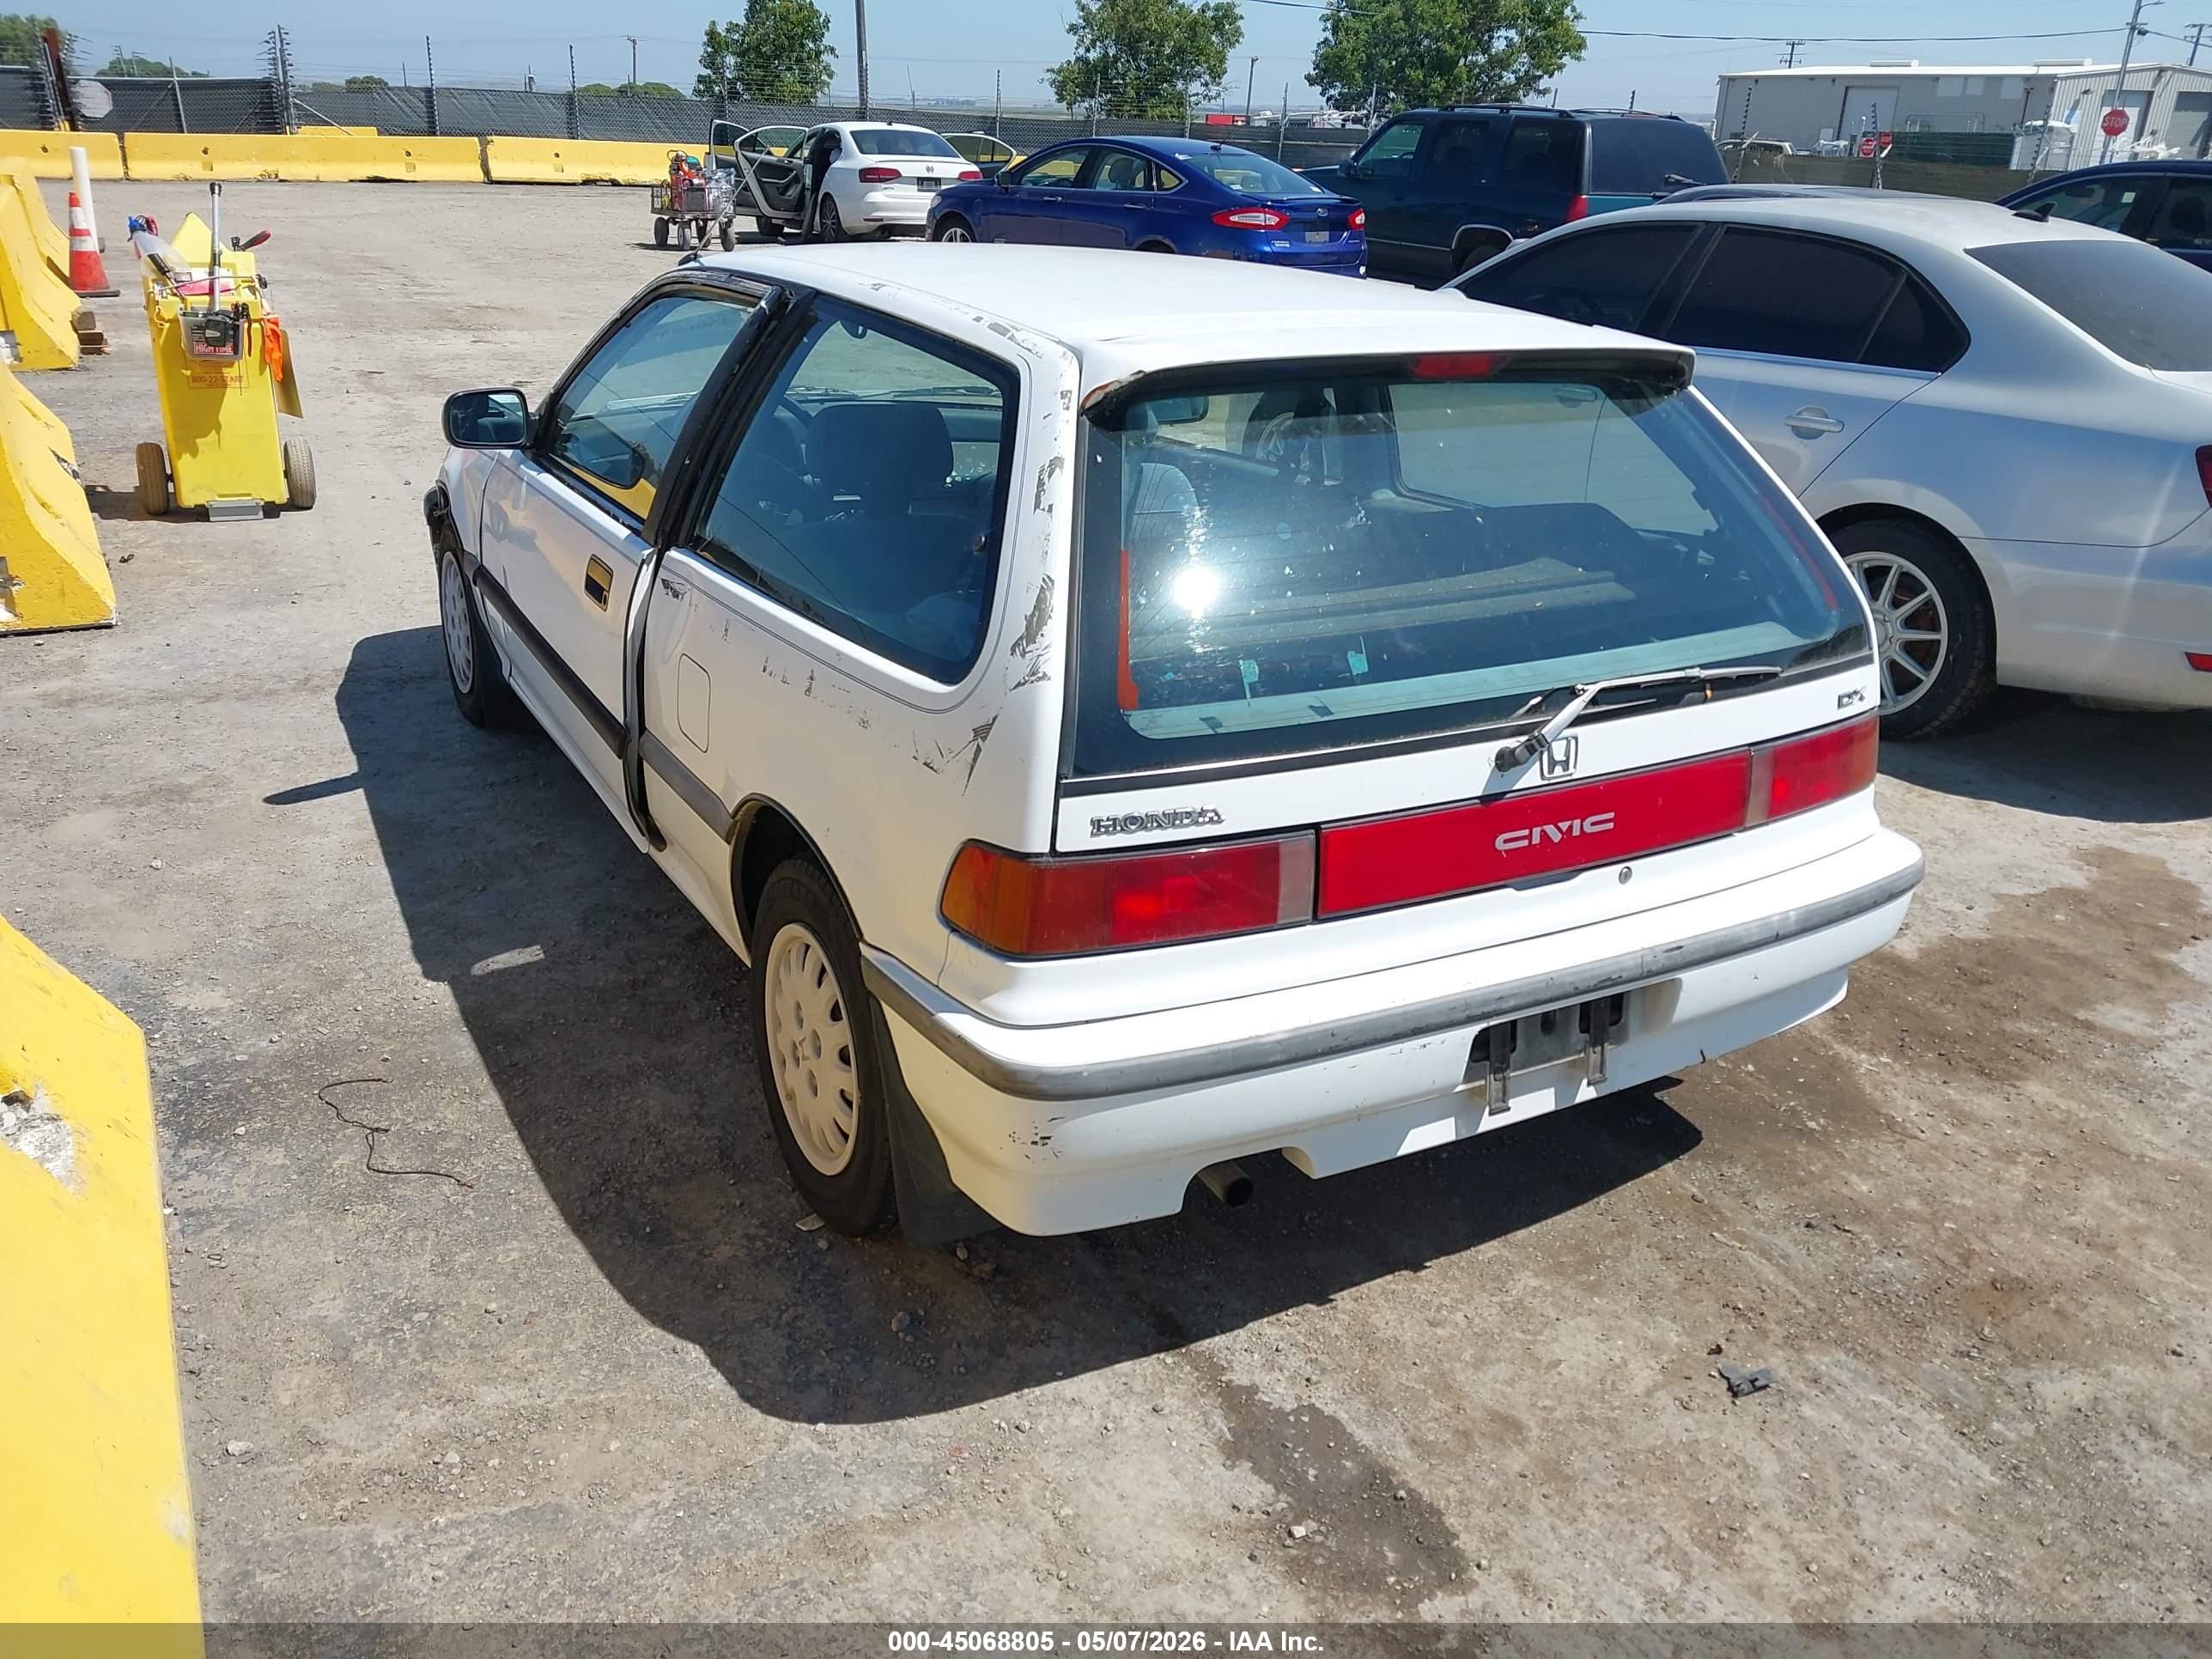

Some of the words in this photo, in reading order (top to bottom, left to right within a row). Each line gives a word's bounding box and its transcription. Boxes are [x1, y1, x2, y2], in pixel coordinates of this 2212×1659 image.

[2103, 116, 2128, 128] STOP
[1838, 686, 1867, 709] DX
[1091, 804, 1225, 838] HONDA
[1495, 811, 1615, 851] CIVIC
